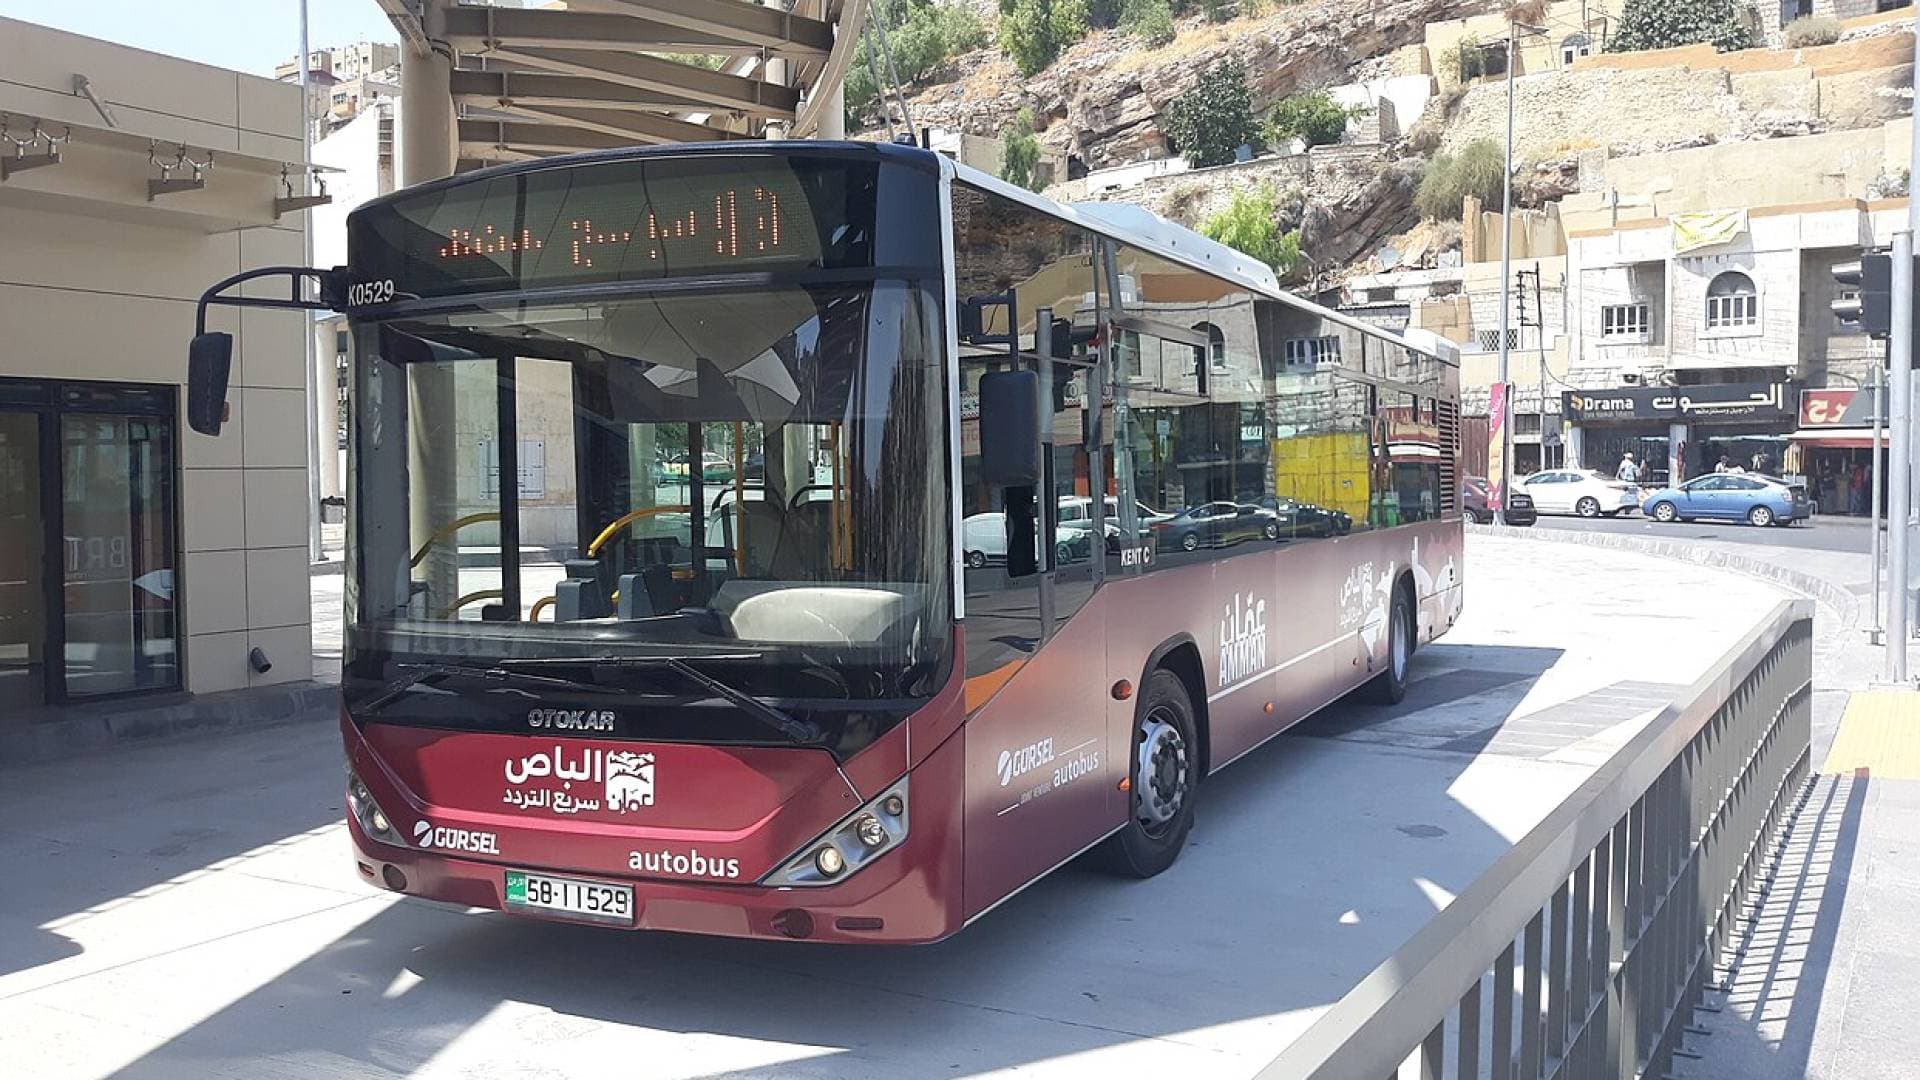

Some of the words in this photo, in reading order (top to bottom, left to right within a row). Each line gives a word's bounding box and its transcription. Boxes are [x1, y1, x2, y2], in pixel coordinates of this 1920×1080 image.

[348, 279, 395, 307] K0529
[1584, 397, 1634, 410] Drama
[1652, 383, 1783, 413] الحوت
[1120, 547, 1142, 567] KENT
[1142, 546, 1150, 564] C
[1219, 632, 1266, 687] AMMAN
[527, 708, 616, 732] OTOKAR
[504, 745, 603, 790] الباص
[1052, 751, 1099, 787] autobus
[502, 788, 551, 810] التردد
[552, 790, 600, 814] سريع
[628, 848, 740, 879] autobus
